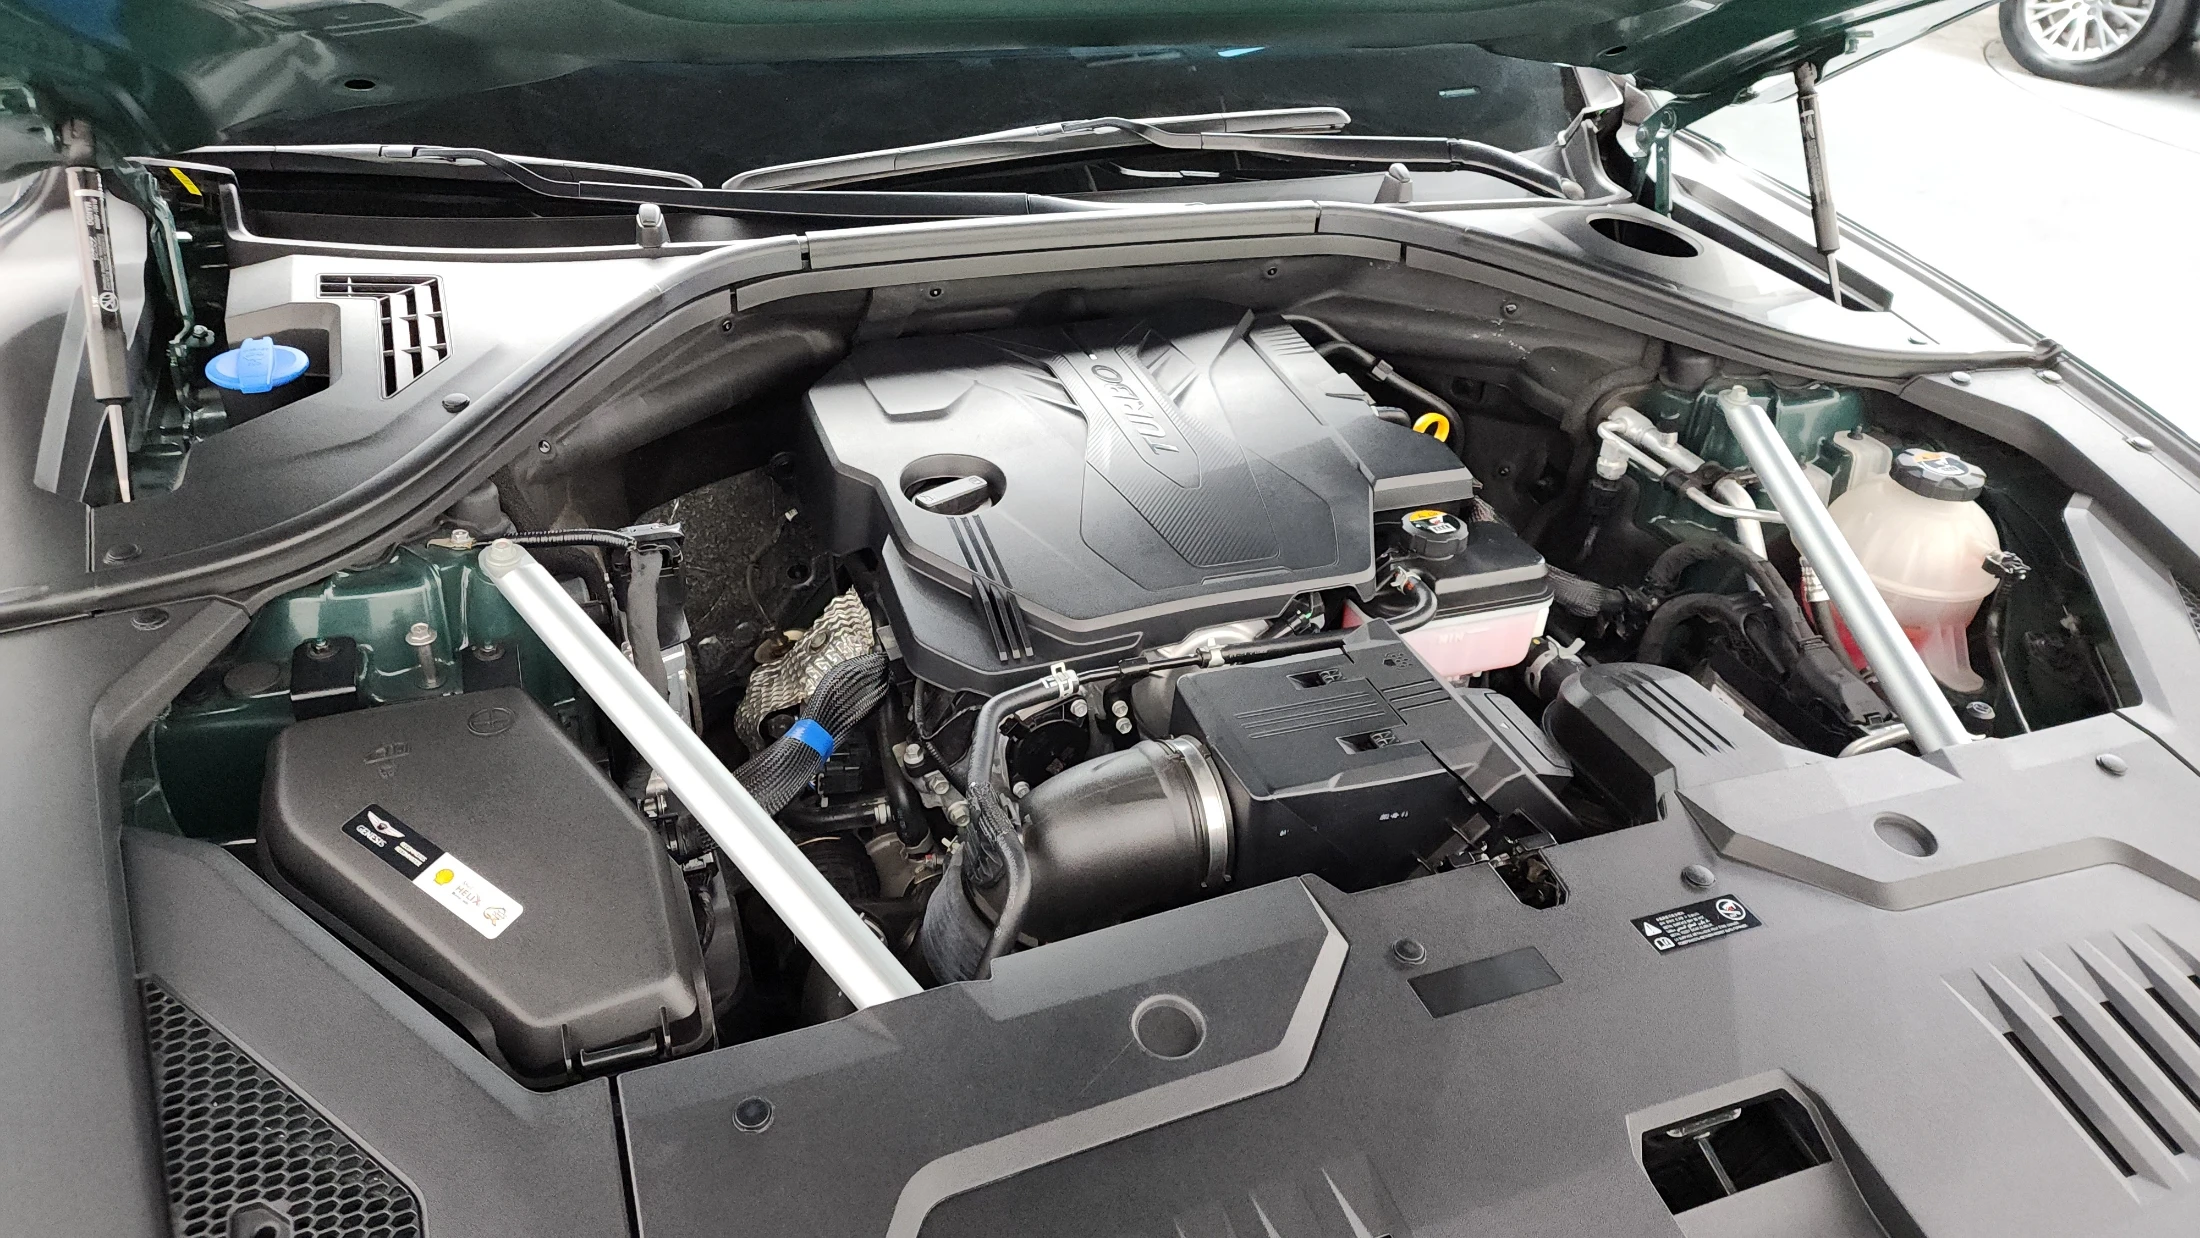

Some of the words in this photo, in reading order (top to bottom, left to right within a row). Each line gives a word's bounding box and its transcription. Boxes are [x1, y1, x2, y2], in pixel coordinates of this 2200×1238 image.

[1091, 365, 1179, 455] TURBO
[356, 824, 387, 848] GENESIS
[455, 884, 481, 906] HELIX
